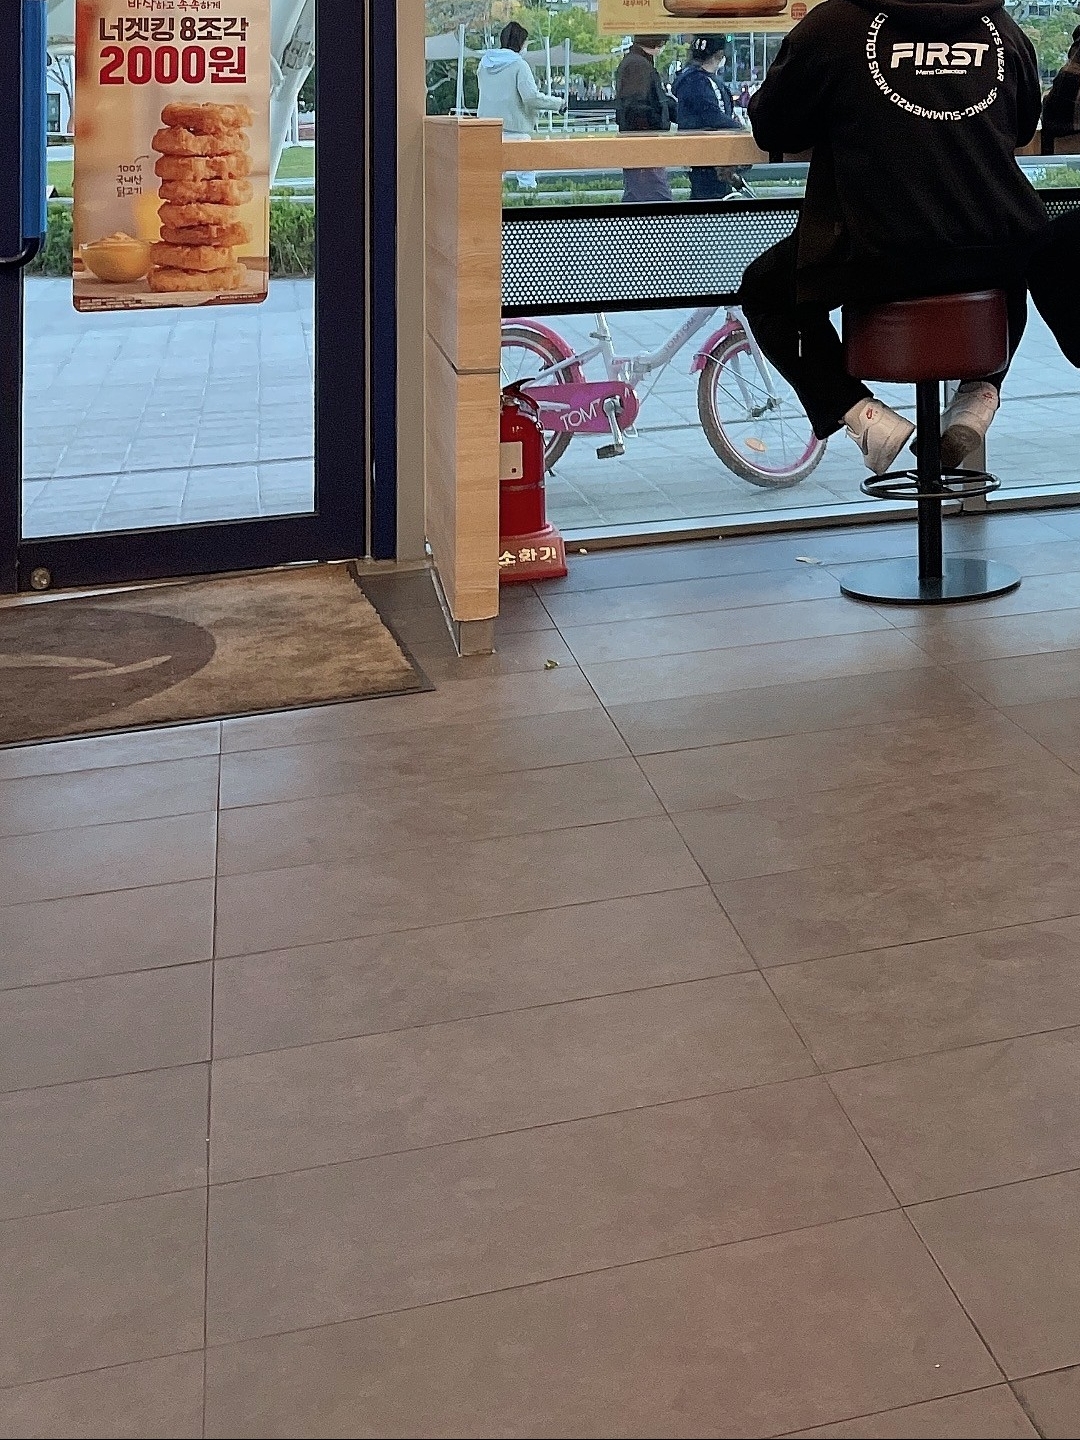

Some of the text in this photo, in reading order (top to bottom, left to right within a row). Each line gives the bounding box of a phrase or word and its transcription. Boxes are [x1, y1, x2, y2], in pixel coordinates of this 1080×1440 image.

[99, 16, 249, 42] 너겟킹 8조각
[100, 45, 247, 85] 2000원
[890, 42, 990, 69] FIRST
[996, 47, 1005, 82] WEAR
[868, 61, 893, 95] MENS
[115, 174, 143, 185] 국내산
[118, 164, 142, 172] 100%
[116, 186, 142, 198] 닭고기
[499, 546, 557, 566] 소화기
